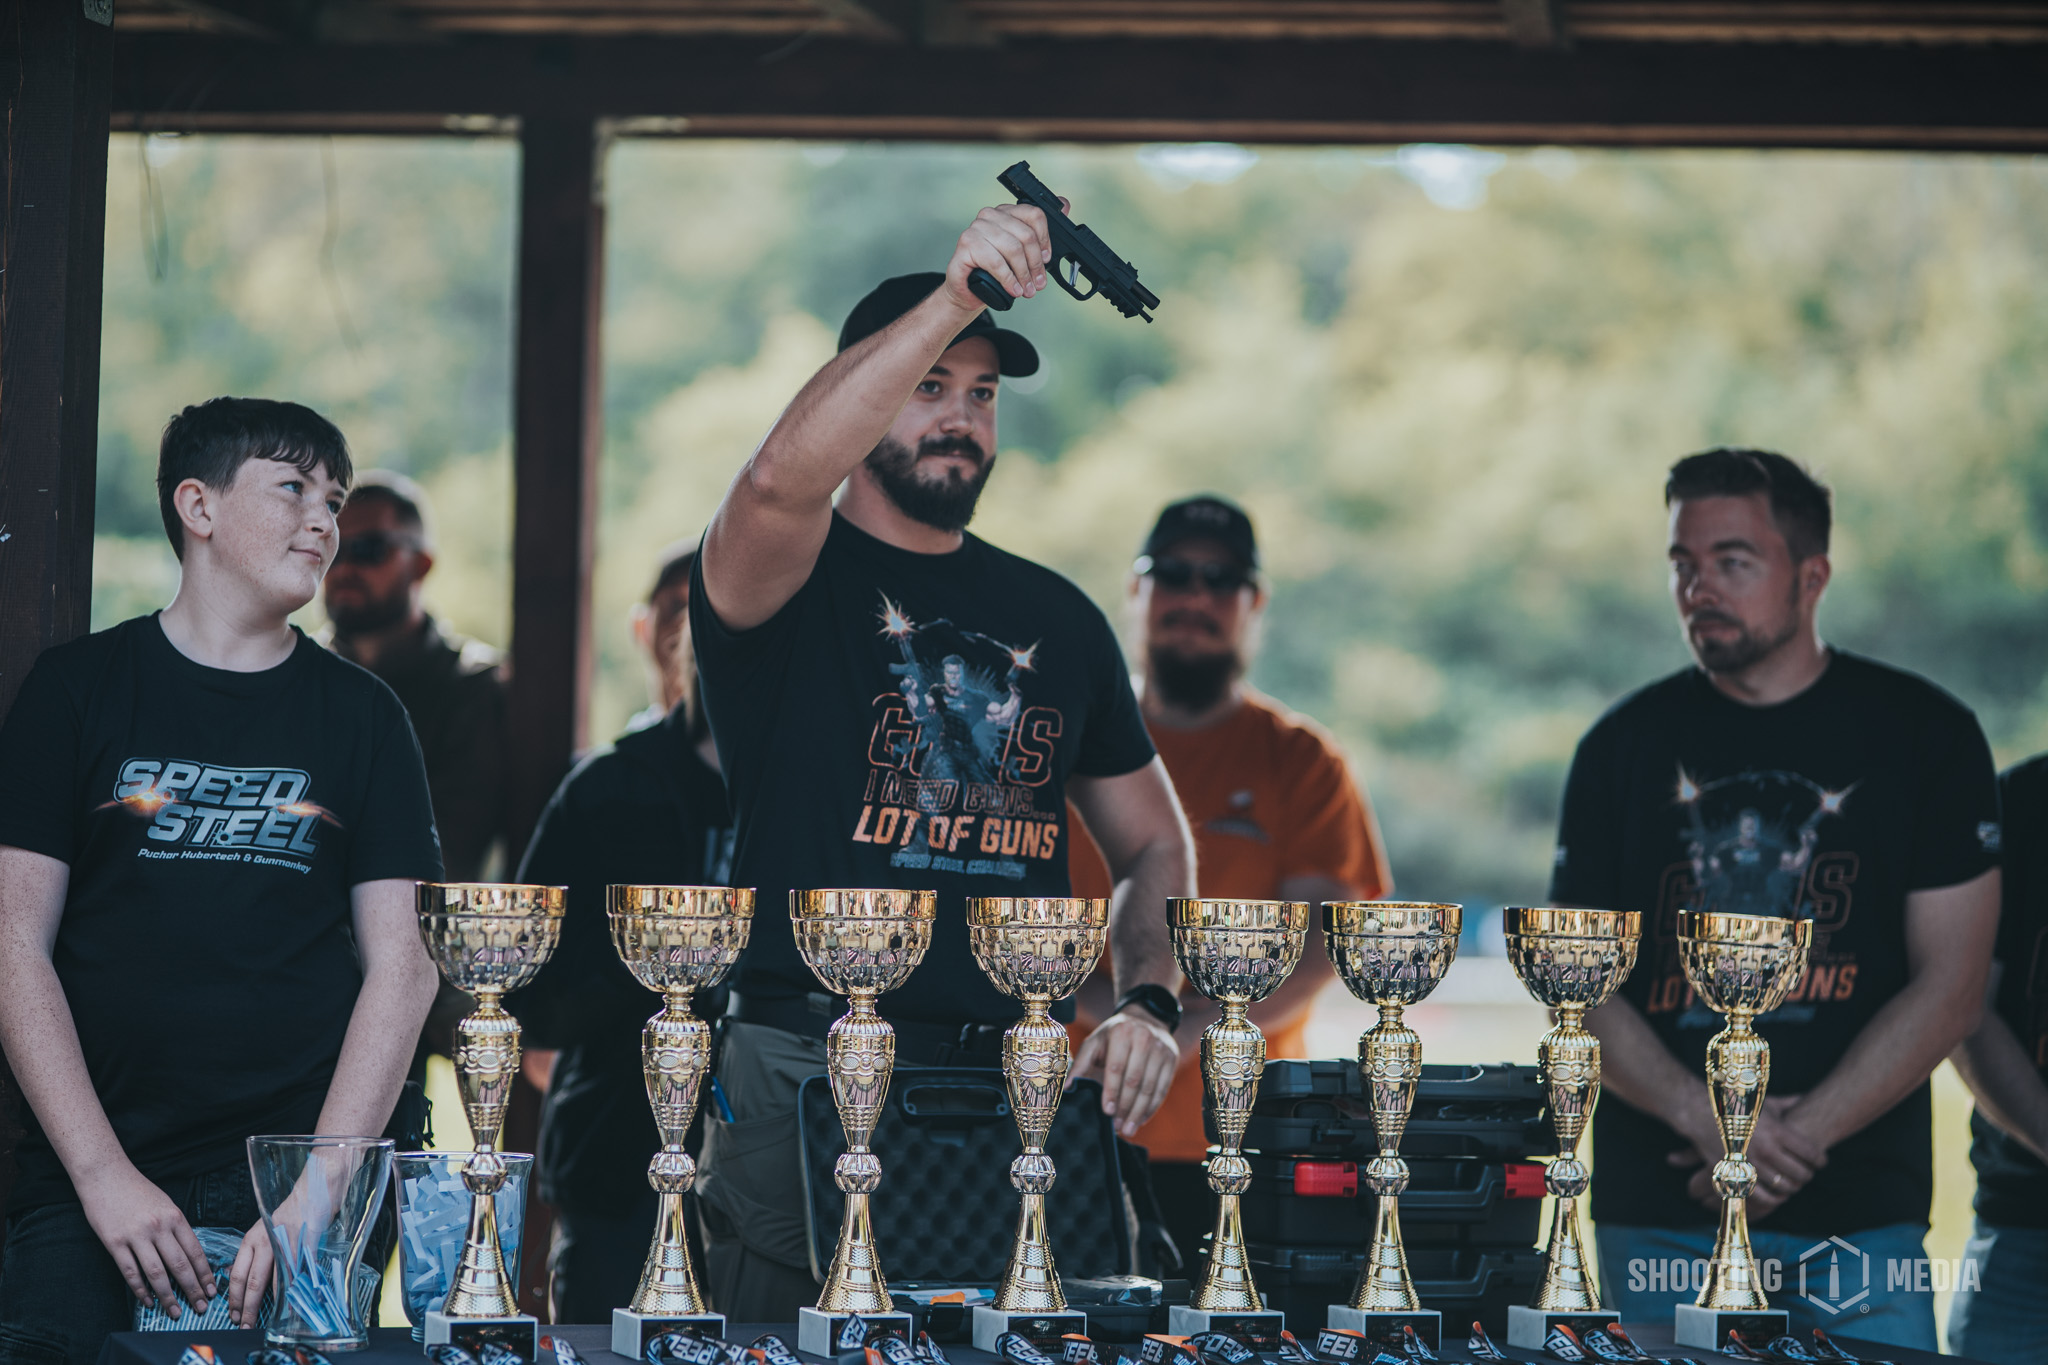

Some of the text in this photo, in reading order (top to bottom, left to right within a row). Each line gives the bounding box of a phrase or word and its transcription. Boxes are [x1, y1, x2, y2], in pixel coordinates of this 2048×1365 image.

[117, 759, 308, 808] SPEED
[879, 770, 960, 813] NEED
[147, 804, 320, 853] STEEL
[852, 805, 1059, 860] LOT OF GUNS
[137, 847, 312, 875] Puchar Hubertech & Gunmonkey
